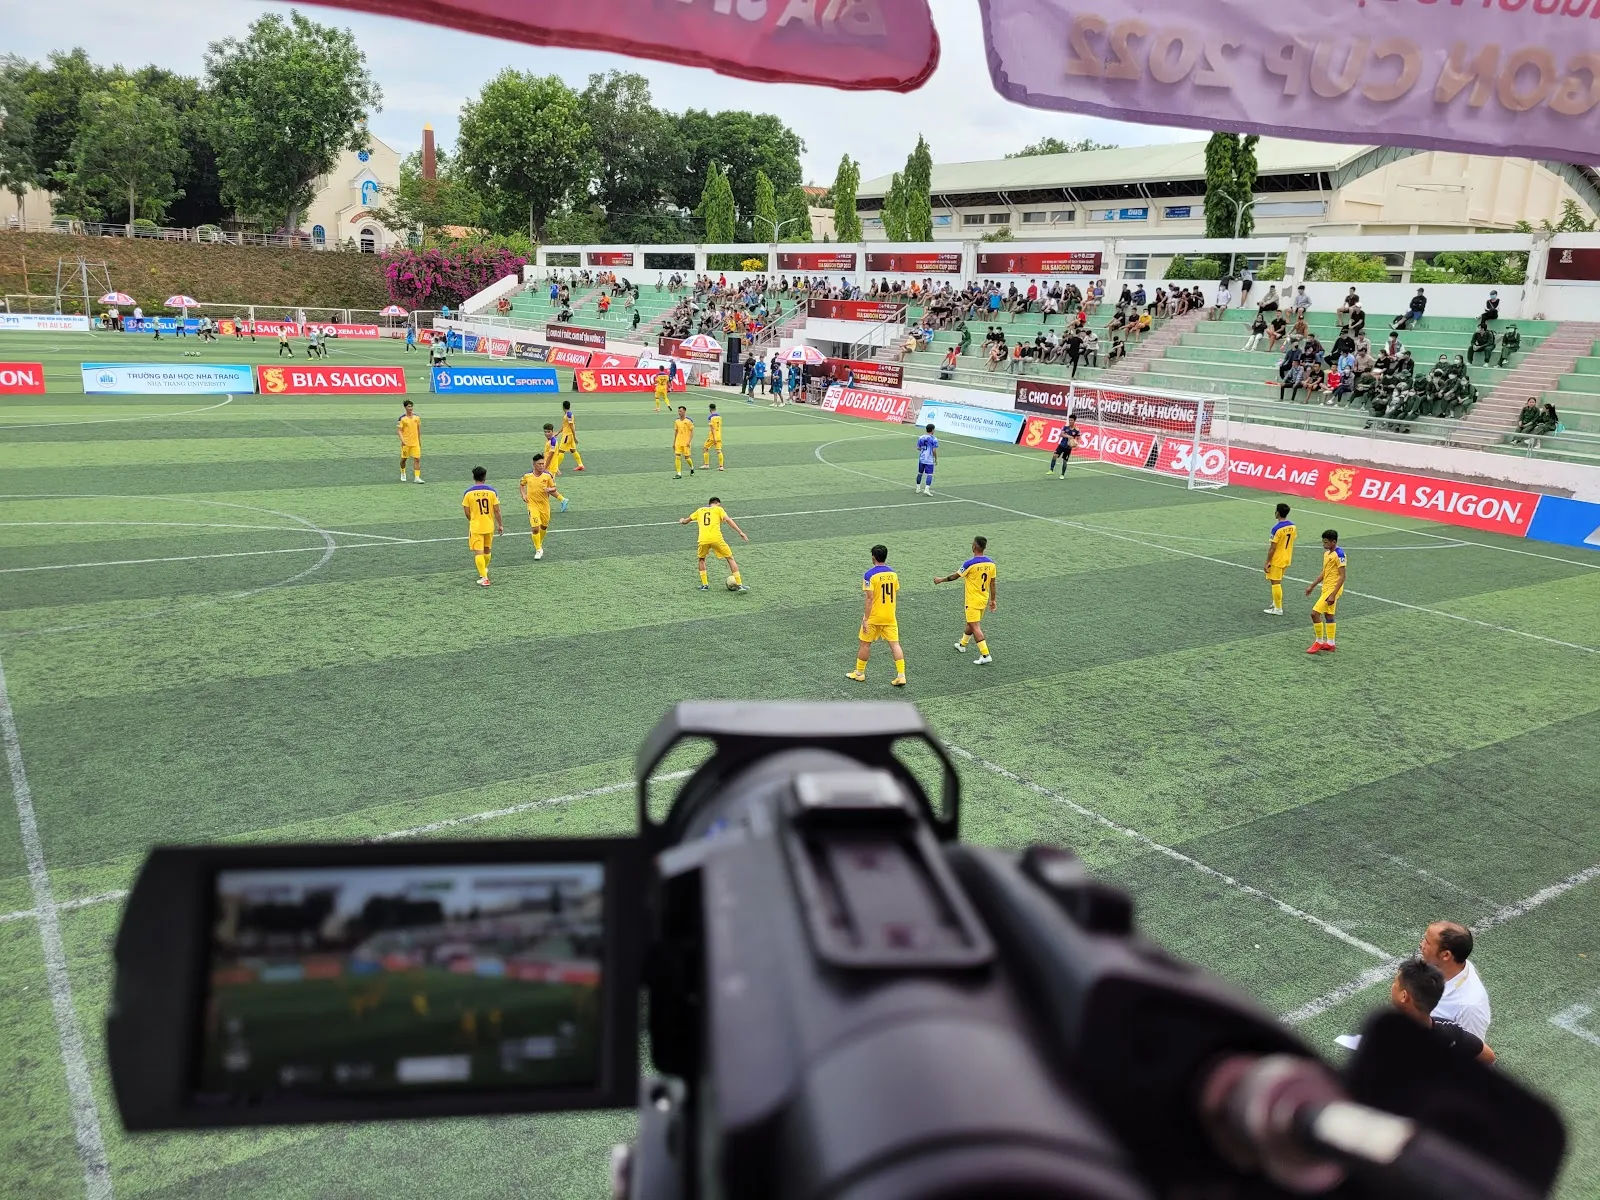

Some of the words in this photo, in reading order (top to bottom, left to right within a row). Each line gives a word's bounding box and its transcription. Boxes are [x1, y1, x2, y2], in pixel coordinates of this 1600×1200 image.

[292, 373, 328, 387] BIA
[330, 373, 399, 387] SAIGON
[453, 375, 515, 386] DONGLUC
[600, 374, 627, 386] BIA
[840, 391, 906, 416] JOGARBOLA
[1050, 392, 1063, 406] CÓ
[1171, 444, 1225, 475] 360
[1228, 460, 1263, 477] XEM
[1265, 464, 1287, 481] LÀ
[1289, 469, 1319, 486] MÊ
[476, 499, 489, 515] 19
[1359, 478, 1406, 504] BIA
[1412, 486, 1521, 524] SAIGON
[703, 511, 711, 526] 6
[982, 573, 987, 592] 2
[881, 583, 893, 604] 14
